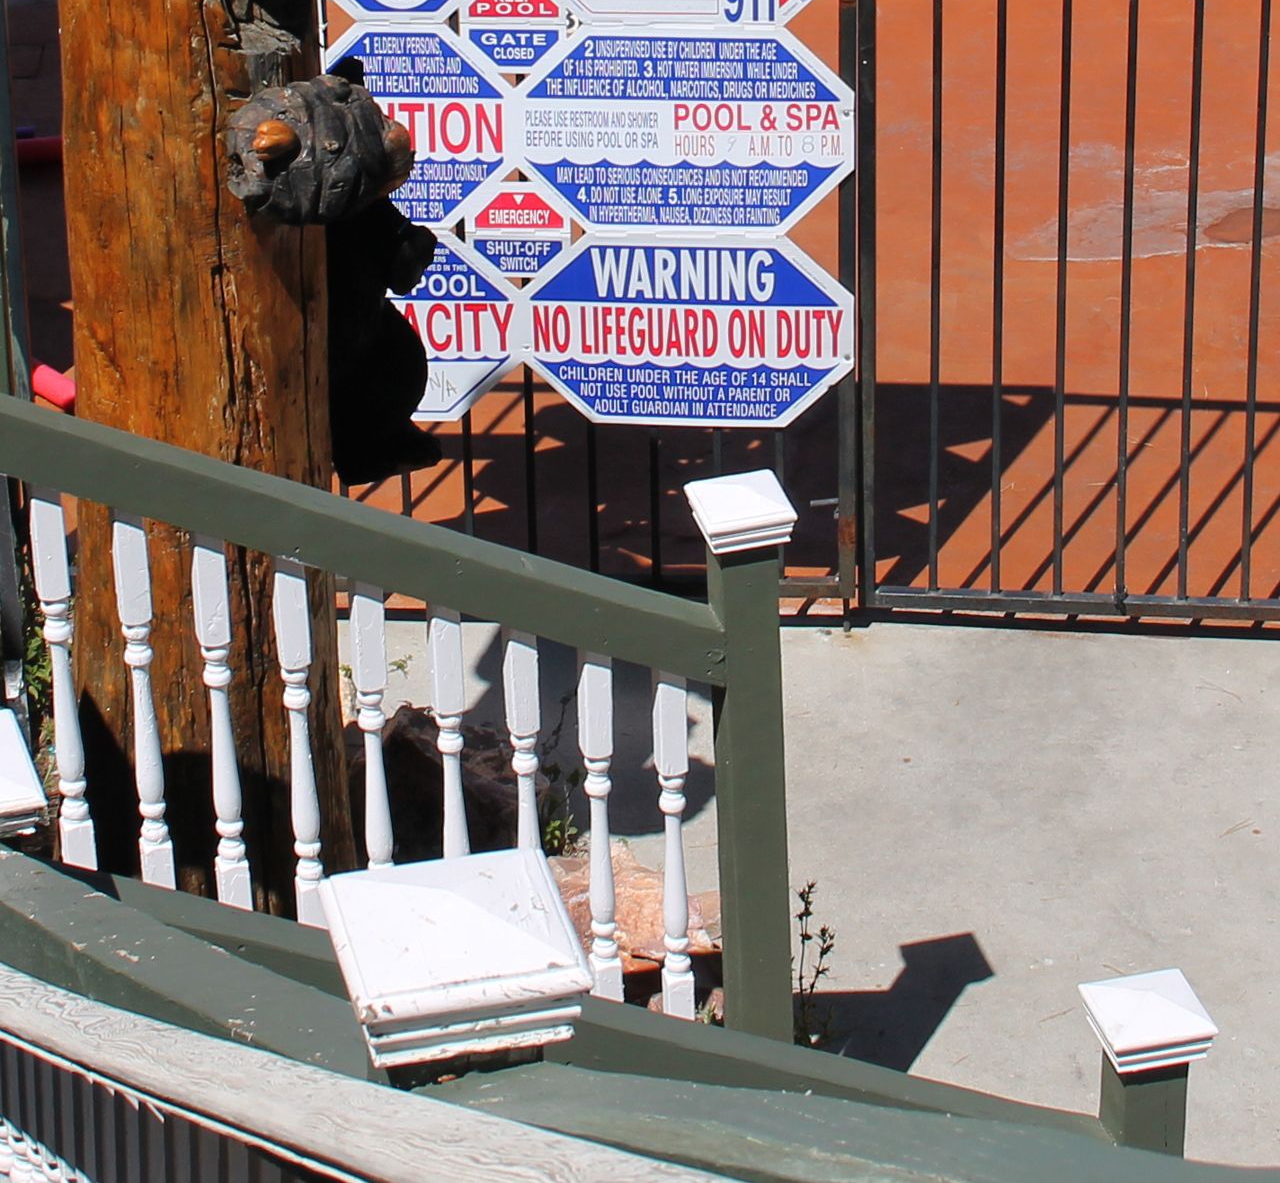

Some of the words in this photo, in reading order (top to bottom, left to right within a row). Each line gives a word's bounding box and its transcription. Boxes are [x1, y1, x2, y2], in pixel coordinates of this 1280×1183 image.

[477, 3, 553, 14] POOL
[364, 38, 369, 53] 1
[374, 38, 404, 54] ELDERLY
[406, 38, 442, 54] PERSONS,
[481, 33, 547, 46] GATE
[493, 48, 534, 60] CLOSED
[584, 42, 593, 58] 2
[595, 42, 649, 58] UNSUPERVISED
[651, 43, 665, 59] USE
[667, 43, 676, 59] BY
[679, 43, 715, 60] CHILDREN
[719, 43, 743, 60] UNDER
[746, 44, 758, 60] THE
[761, 44, 776, 60] AGE
[564, 60, 572, 76] OF
[575, 61, 583, 76] 14
[585, 61, 592, 76] IS
[594, 61, 639, 76] PROHIBITED.
[644, 61, 656, 77] 3.
[657, 61, 671, 77] HOT
[674, 62, 699, 77] WATER
[700, 62, 742, 78] IMMERSION
[746, 62, 769, 78] WHILE
[771, 62, 797, 79] UNDER
[386, 76, 419, 93] HEALTH
[422, 76, 478, 94] CONDITIONS
[547, 79, 561, 95] THE
[564, 79, 610, 96] INFLUENCE
[612, 80, 623, 96] OF
[626, 80, 668, 97] ALCOHOL,
[670, 80, 720, 97] NARCOTICS,
[723, 81, 752, 98] DRUGS
[754, 82, 766, 98] OR
[769, 82, 815, 99] MEDICINES
[526, 111, 551, 127] PLEASE
[554, 111, 567, 127] USE
[569, 111, 608, 128] RESTROOM
[611, 112, 625, 128] AND
[627, 112, 658, 128] SHOWER
[674, 103, 751, 130] POOL
[760, 104, 778, 130] &
[786, 104, 840, 131] SPA
[526, 131, 562, 147] BEFORE
[565, 131, 593, 147] USING
[596, 132, 621, 148] POOL
[624, 132, 637, 148] OR
[641, 132, 658, 148] SPA
[674, 137, 715, 156] HOURS
[777, 137, 792, 156] TO
[821, 138, 844, 156] P.M.
[557, 168, 572, 183] MAY
[574, 168, 593, 183] LEAD
[596, 168, 605, 183] TO
[608, 168, 639, 184] SERIOUS
[642, 168, 702, 184] CONSEQUENCES
[705, 169, 720, 184] AND
[722, 169, 729, 184] IS
[731, 169, 746, 185] NOT
[748, 169, 807, 185] RECOMMENDED
[578, 187, 589, 202] 4.
[590, 187, 602, 203] DO
[603, 188, 618, 203] NOT
[620, 188, 635, 203] USE
[637, 188, 664, 203] ALONE.
[668, 188, 680, 204] 5.
[682, 188, 702, 204] LONG
[704, 188, 743, 204] EXPOSURE
[745, 189, 760, 205] MAY
[762, 189, 790, 205] RESULT
[489, 210, 550, 224] EMERGENCY
[590, 206, 596, 221] IN
[599, 206, 658, 222] HYPERTHERMIA,
[660, 207, 692, 222] NAUSEA,
[693, 207, 731, 223] DIZZINESS
[733, 208, 744, 224] OR
[746, 208, 780, 224] FAINTING
[486, 242, 550, 256] SHUT-OFF
[500, 256, 538, 270] SWITCH
[590, 248, 775, 302] WARNING
[532, 305, 569, 354] NO
[580, 306, 717, 356] LIFEGUARD
[728, 308, 764, 357] ON
[776, 309, 843, 358] DUTY
[560, 367, 622, 381] CHILDREN
[627, 368, 669, 382] UNDER
[676, 370, 697, 383] THE
[702, 370, 726, 384] AGE
[731, 371, 746, 384] OF
[753, 372, 765, 385] 14
[770, 372, 811, 386] SHALL
[580, 383, 600, 397] NOT
[606, 384, 626, 397] USE
[630, 384, 660, 398] POOL
[663, 385, 712, 400] WITHOUT
[718, 387, 724, 400] A
[728, 387, 769, 401] PARENT
[774, 388, 790, 402] OR
[594, 400, 626, 413] ADULT
[632, 400, 688, 415] GUARDIAN
[692, 402, 702, 415] IN
[707, 402, 776, 417] ATTENDANCE
